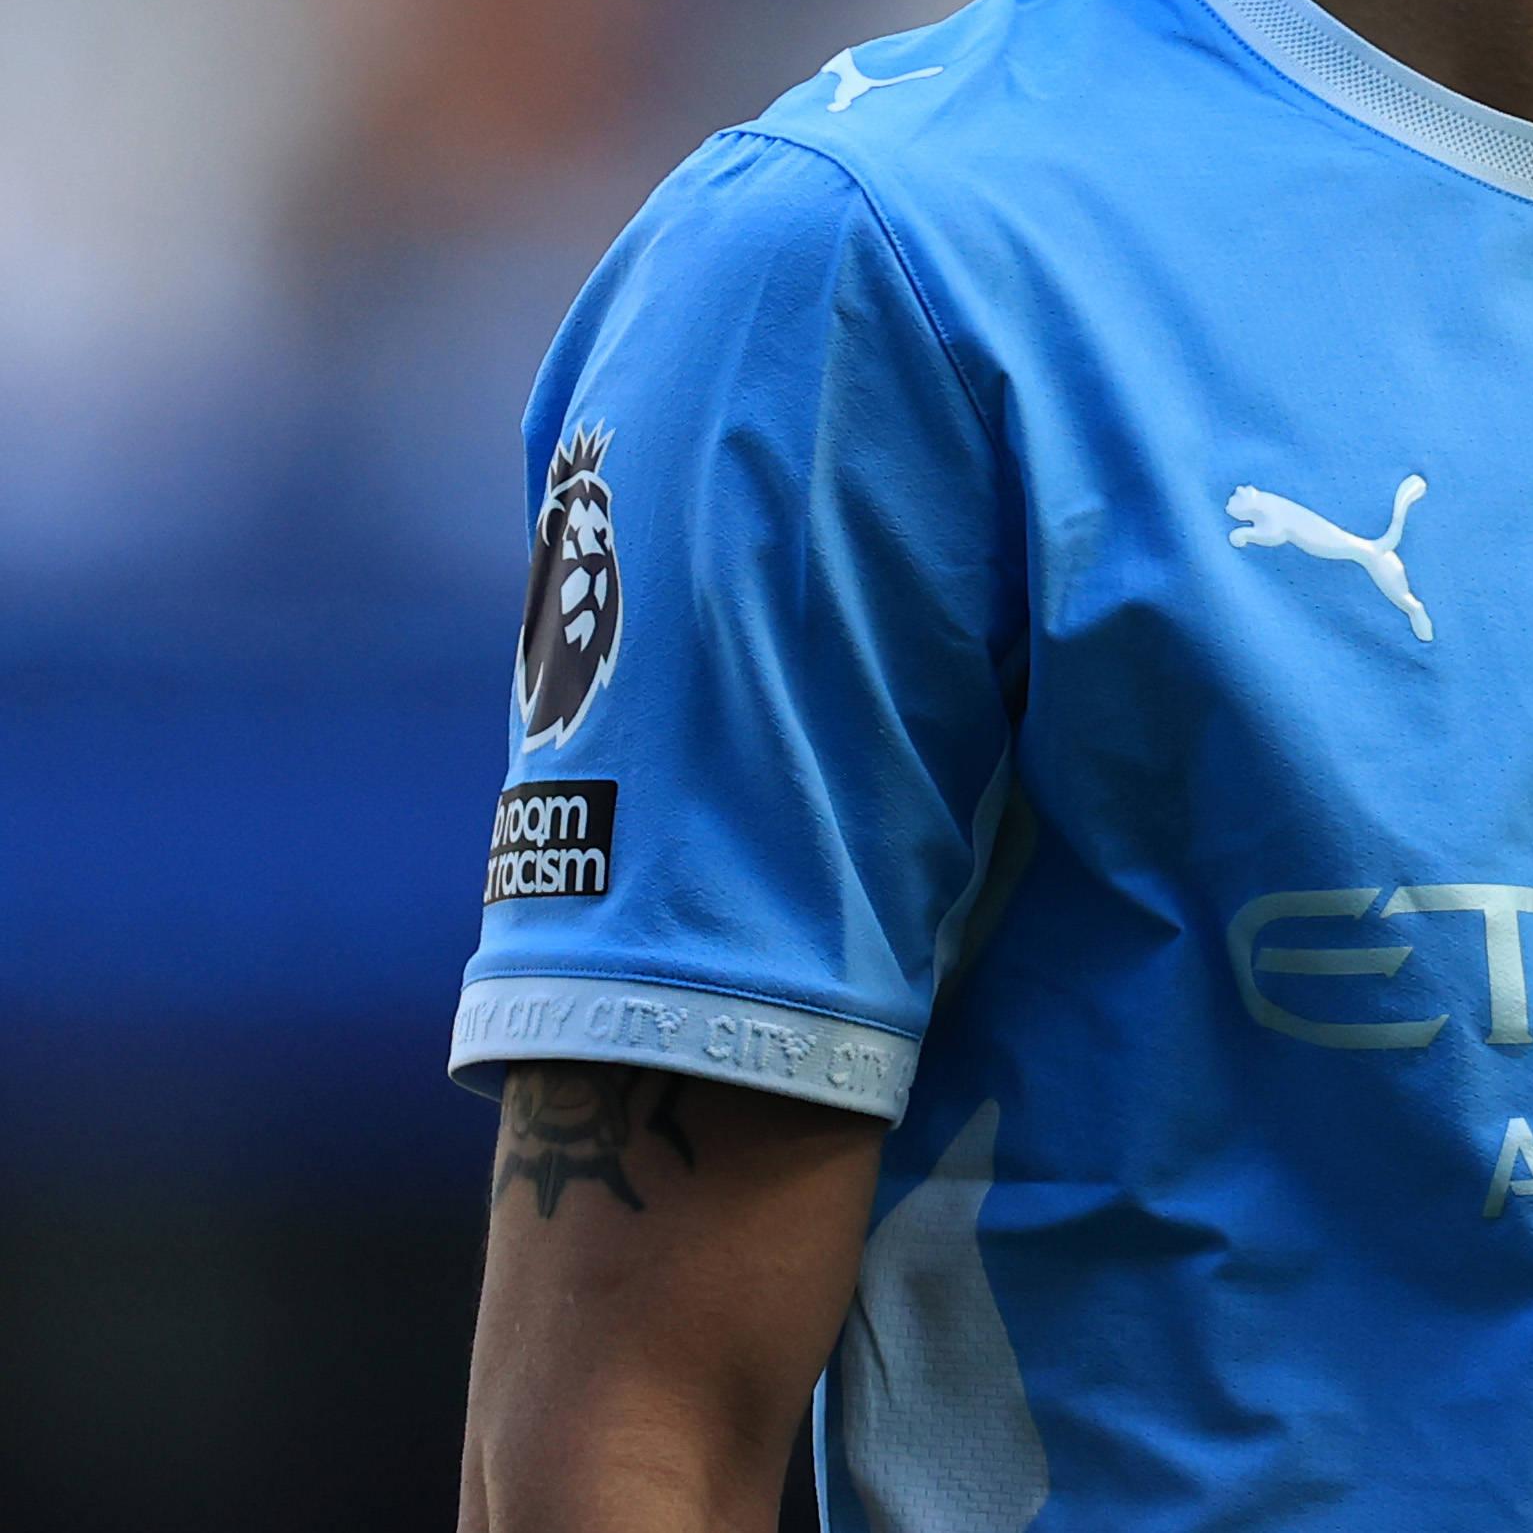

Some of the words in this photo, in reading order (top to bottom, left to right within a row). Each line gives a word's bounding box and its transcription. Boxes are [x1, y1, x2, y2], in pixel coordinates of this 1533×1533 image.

[502, 795, 588, 847] room
[495, 847, 606, 899] racism
[504, 995, 576, 1039] CITY
[584, 996, 688, 1052] CITY
[703, 1015, 817, 1077] CITY
